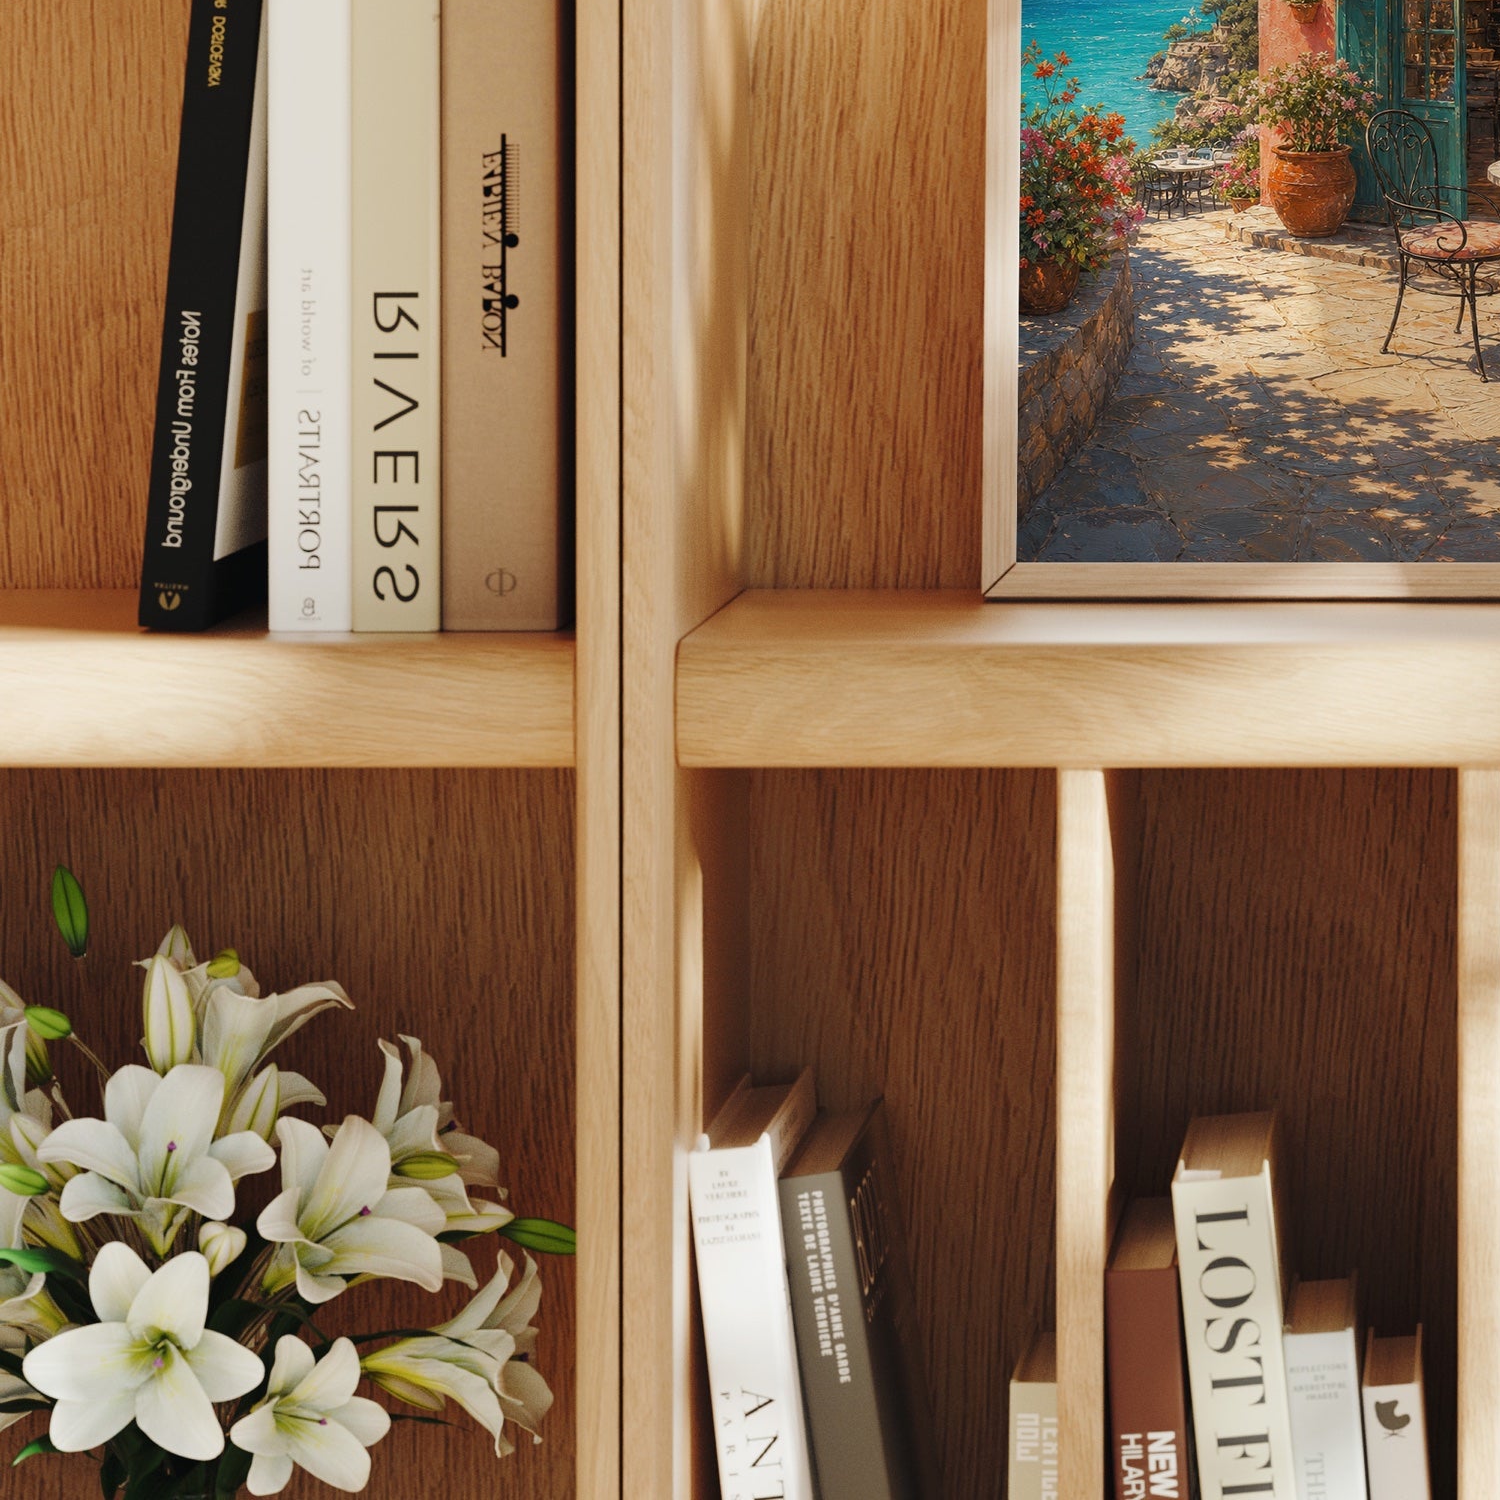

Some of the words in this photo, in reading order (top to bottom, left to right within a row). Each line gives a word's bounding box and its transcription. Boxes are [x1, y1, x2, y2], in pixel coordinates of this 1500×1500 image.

[798, 1192, 813, 1231] TEXTE
[804, 1234, 816, 1250] DE
[812, 1190, 836, 1290] PHOTOGRAPHIES
[806, 1253, 823, 1293] LAURE
[827, 1294, 845, 1339] D'ANNE
[1194, 1204, 1266, 1406] LOST
[835, 1343, 851, 1384] GARDE
[1016, 1413, 1040, 1461] NOW
[1147, 1431, 1179, 1498] NEW
